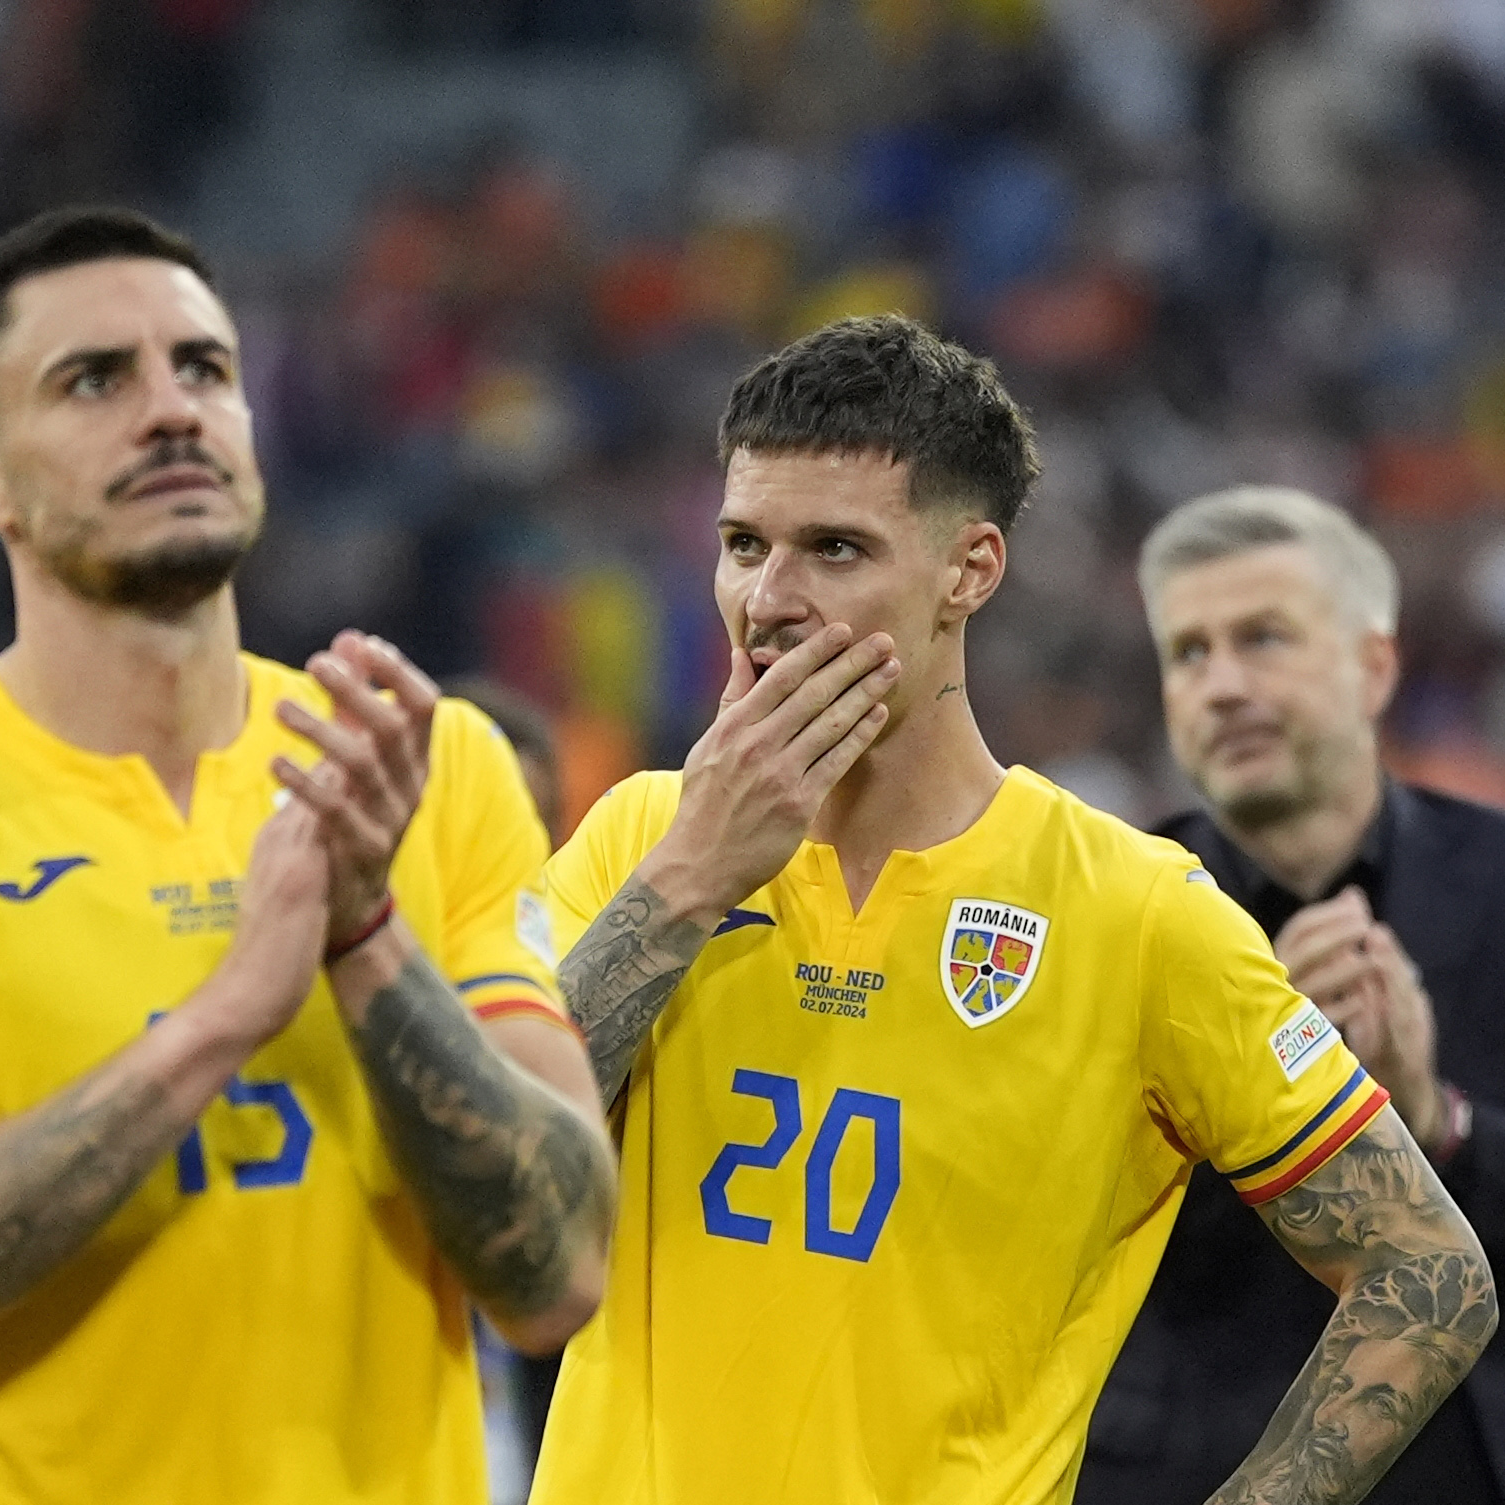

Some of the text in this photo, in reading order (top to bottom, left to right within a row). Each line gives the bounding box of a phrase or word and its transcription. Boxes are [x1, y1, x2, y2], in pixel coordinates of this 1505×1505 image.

[958, 907, 1038, 938] ROMÂNIA
[795, 963, 833, 983] ROU
[845, 969, 885, 991] NED
[805, 984, 868, 1004] MÜNCHEN
[800, 998, 867, 1019] 02.07.2024
[699, 1068, 901, 1263] 20
